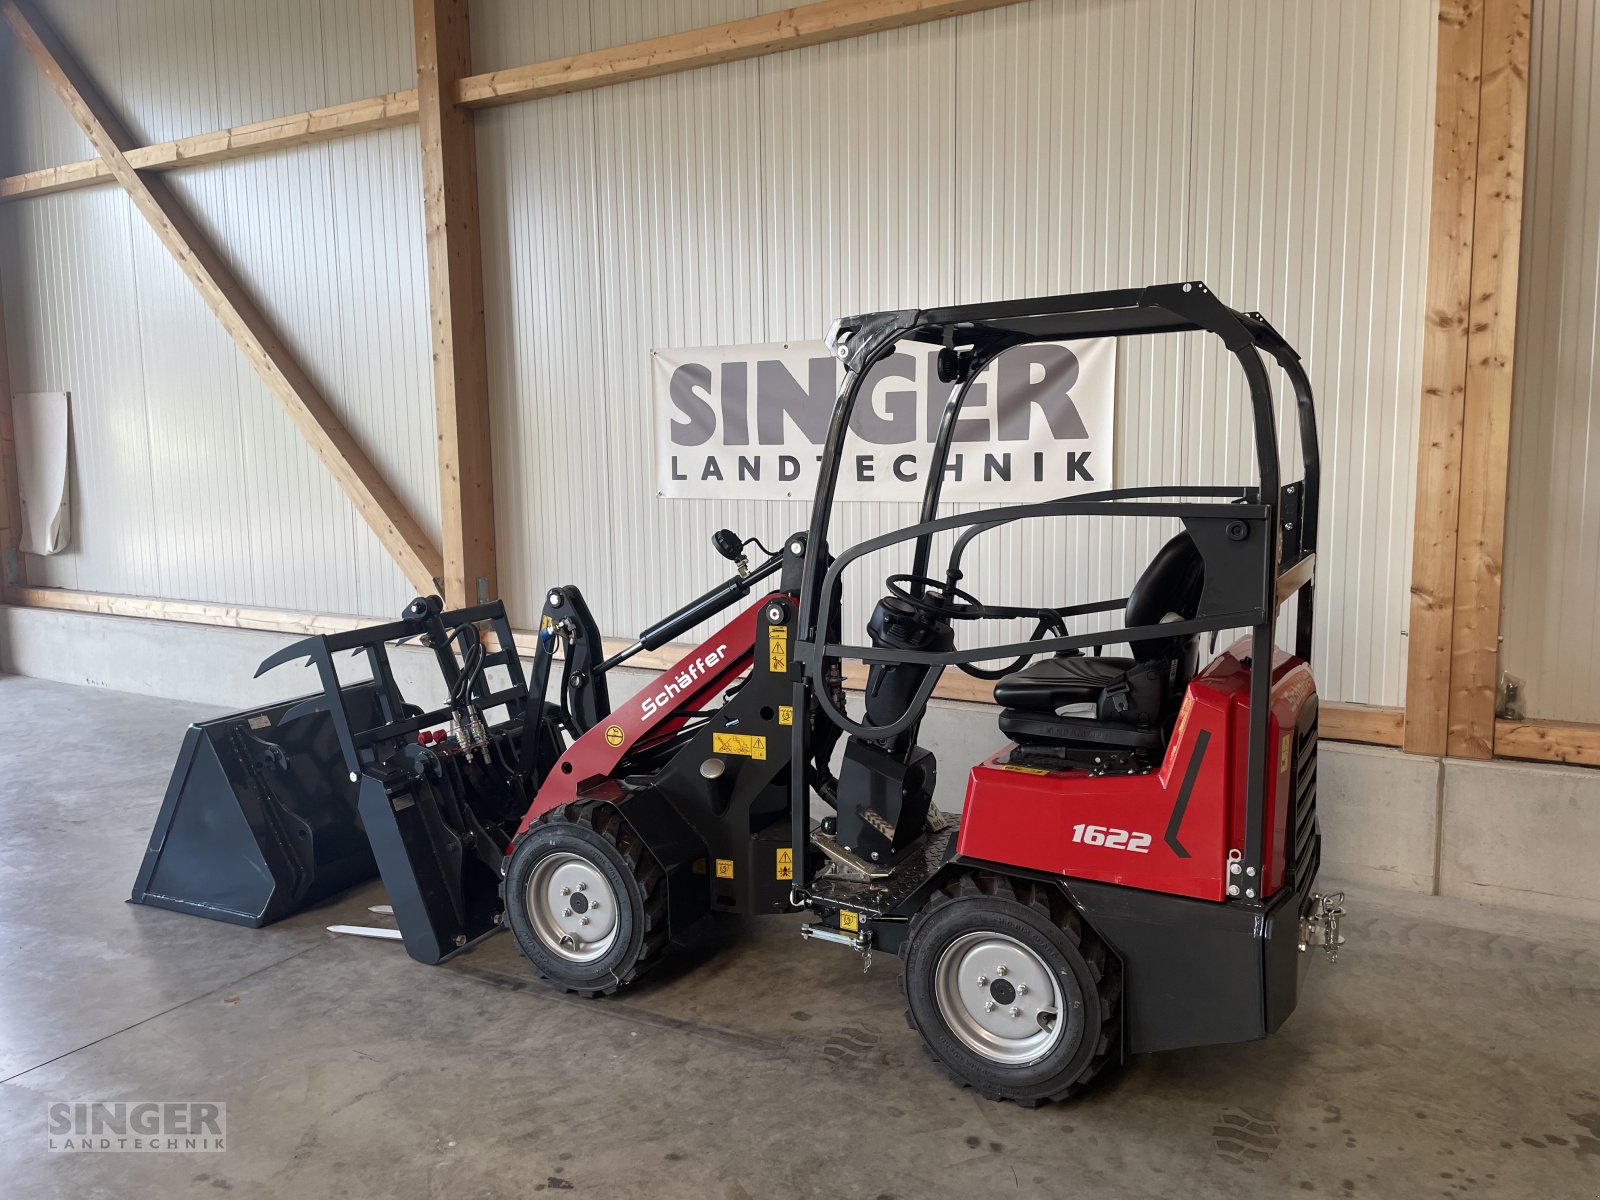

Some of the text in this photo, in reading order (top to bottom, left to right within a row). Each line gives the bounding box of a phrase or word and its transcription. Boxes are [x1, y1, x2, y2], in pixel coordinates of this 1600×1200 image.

[669, 344, 1089, 447] SINGER
[670, 451, 1095, 482] LANDECHNIK
[640, 644, 728, 722] Schäffer
[1071, 823, 1153, 853] 1622
